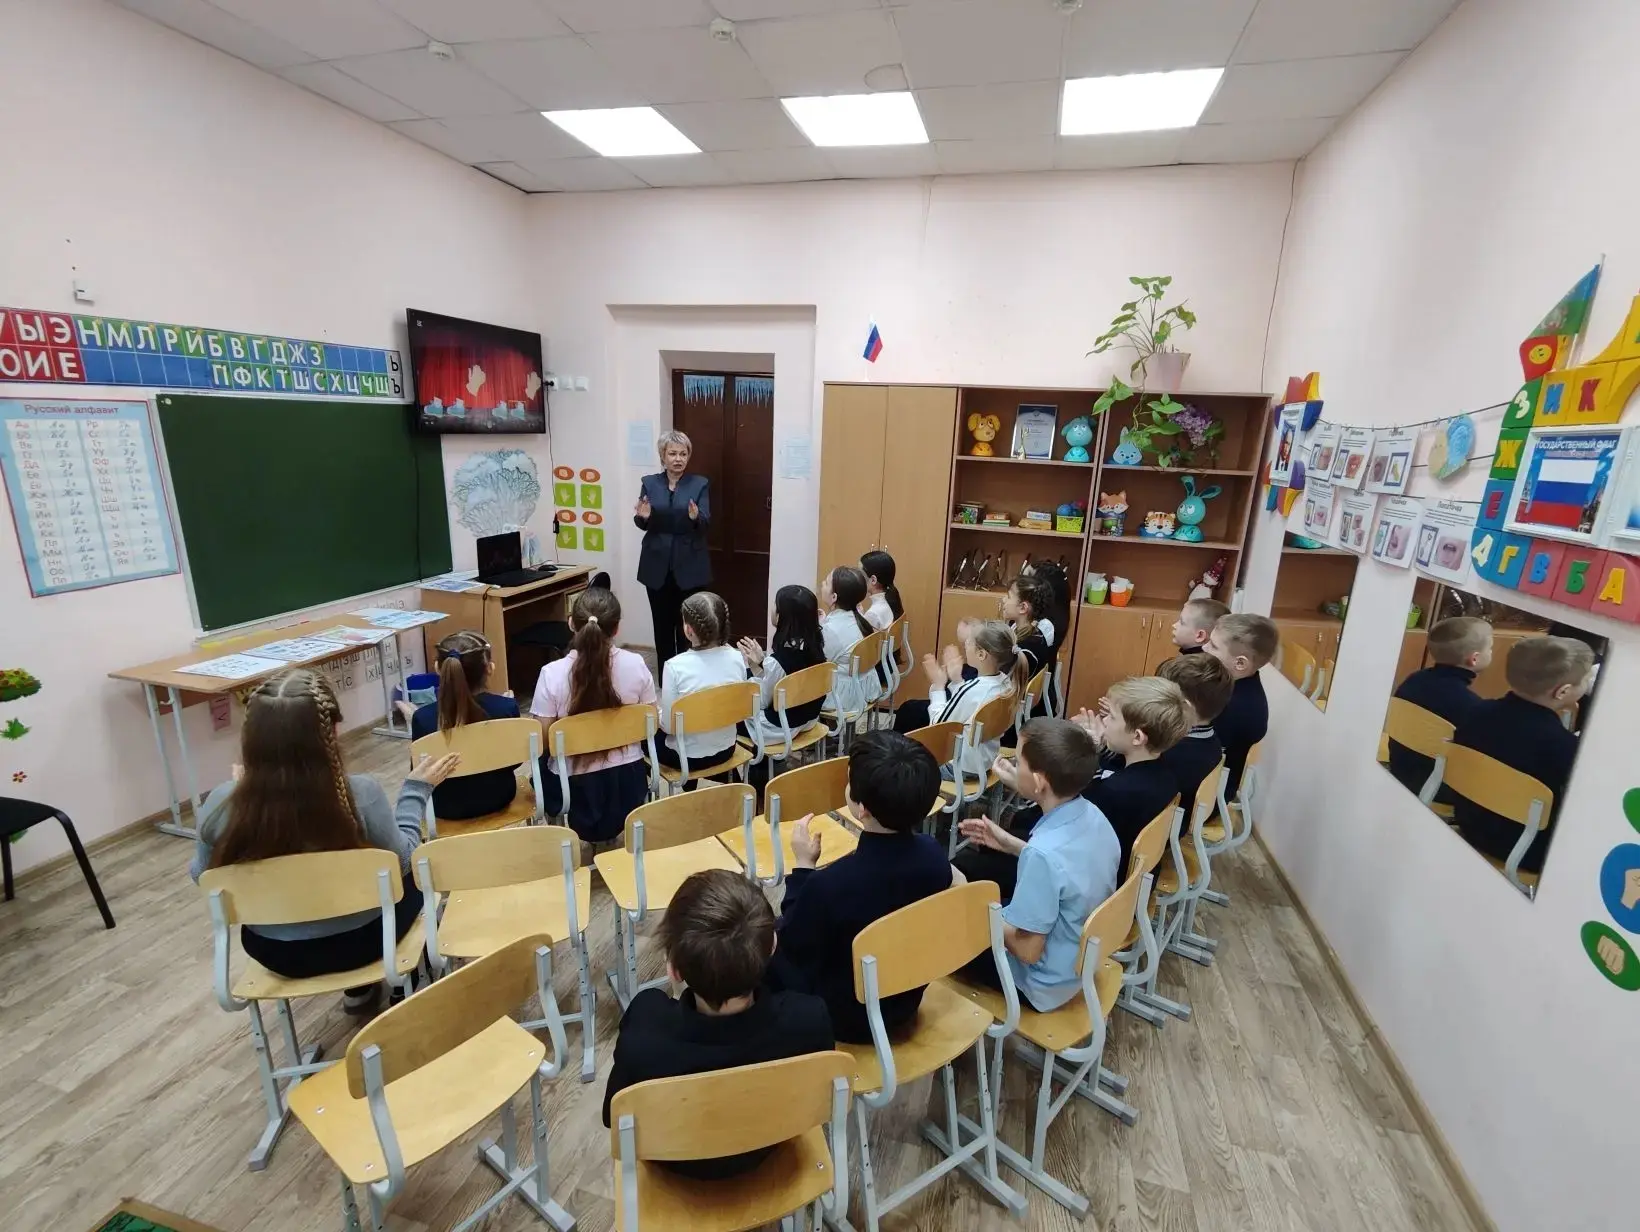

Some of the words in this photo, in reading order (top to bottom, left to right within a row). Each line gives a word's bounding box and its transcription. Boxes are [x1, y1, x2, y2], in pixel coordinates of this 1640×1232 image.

[16, 314, 45, 342] Ы
[50, 317, 72, 344] Э
[77, 319, 102, 346] Н
[107, 323, 132, 348] М
[136, 326, 156, 350] Л
[163, 328, 178, 352] Р
[185, 330, 205, 354] Й
[207, 334, 223, 357] Б
[230, 337, 245, 359] В
[252, 339, 264, 361] Г
[271, 342, 288, 365] Д
[288, 343, 307, 365] Ж
[310, 346, 322, 366] З
[0, 350, 21, 377] О
[24, 350, 52, 377] И
[58, 352, 80, 379] Е
[212, 364, 229, 386] П
[233, 366, 252, 387] Ф
[256, 368, 271, 389] К
[276, 369, 290, 389] Т
[292, 370, 310, 391] Ш
[313, 371, 326, 391] С
[330, 373, 343, 392] Х
[346, 374, 360, 395] Ц
[362, 375, 373, 393] Ч
[24, 405, 71, 415] Русский
[74, 405, 119, 415] алфавит
[1578, 378, 1602, 413] К
[1494, 440, 1523, 468] Ж
[1485, 490, 1504, 520] Е
[1498, 546, 1520, 574] Г
[1530, 552, 1552, 584] В
[1565, 560, 1592, 594] Б
[1599, 567, 1625, 605] А
